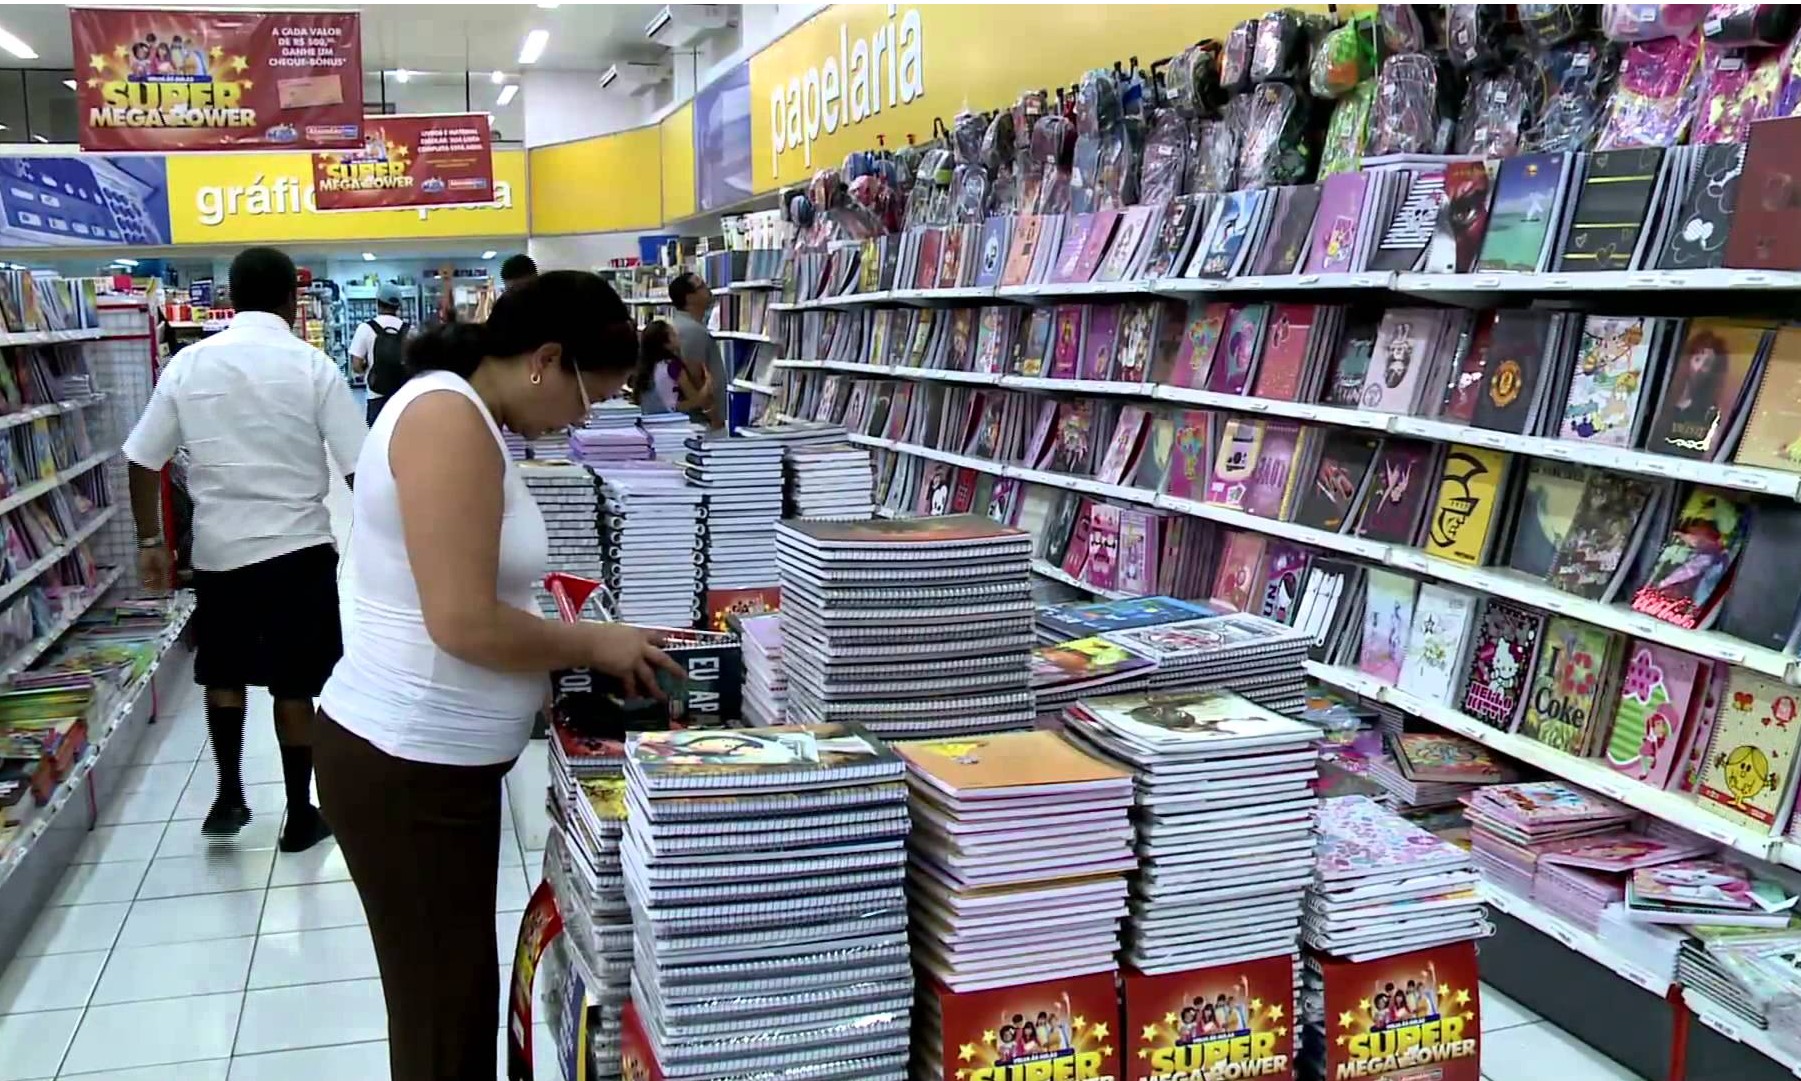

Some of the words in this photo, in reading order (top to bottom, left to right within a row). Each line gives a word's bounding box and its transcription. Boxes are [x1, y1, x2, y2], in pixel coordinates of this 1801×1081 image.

[272, 27, 279, 36] A
[281, 27, 308, 36] CADA
[309, 27, 342, 36] VALOR
[281, 47, 315, 56] GANHE
[317, 47, 334, 56] UM
[102, 81, 242, 110] SUPER
[770, 4, 924, 181] papelaria
[90, 107, 165, 127] MEGA
[319, 178, 362, 192] MEGA
[326, 162, 405, 180] SUPER
[196, 174, 320, 225] gráfi
[688, 657, 720, 682] EU
[1544, 645, 1561, 678] I
[1465, 693, 1512, 723] KITTY
[1470, 681, 1513, 710] HELLO
[1535, 686, 1585, 728] Coke
[1152, 1032, 1276, 1073] SUPER
[1349, 1016, 1467, 1060] SUPER
[1336, 1053, 1399, 1081] MEGA
